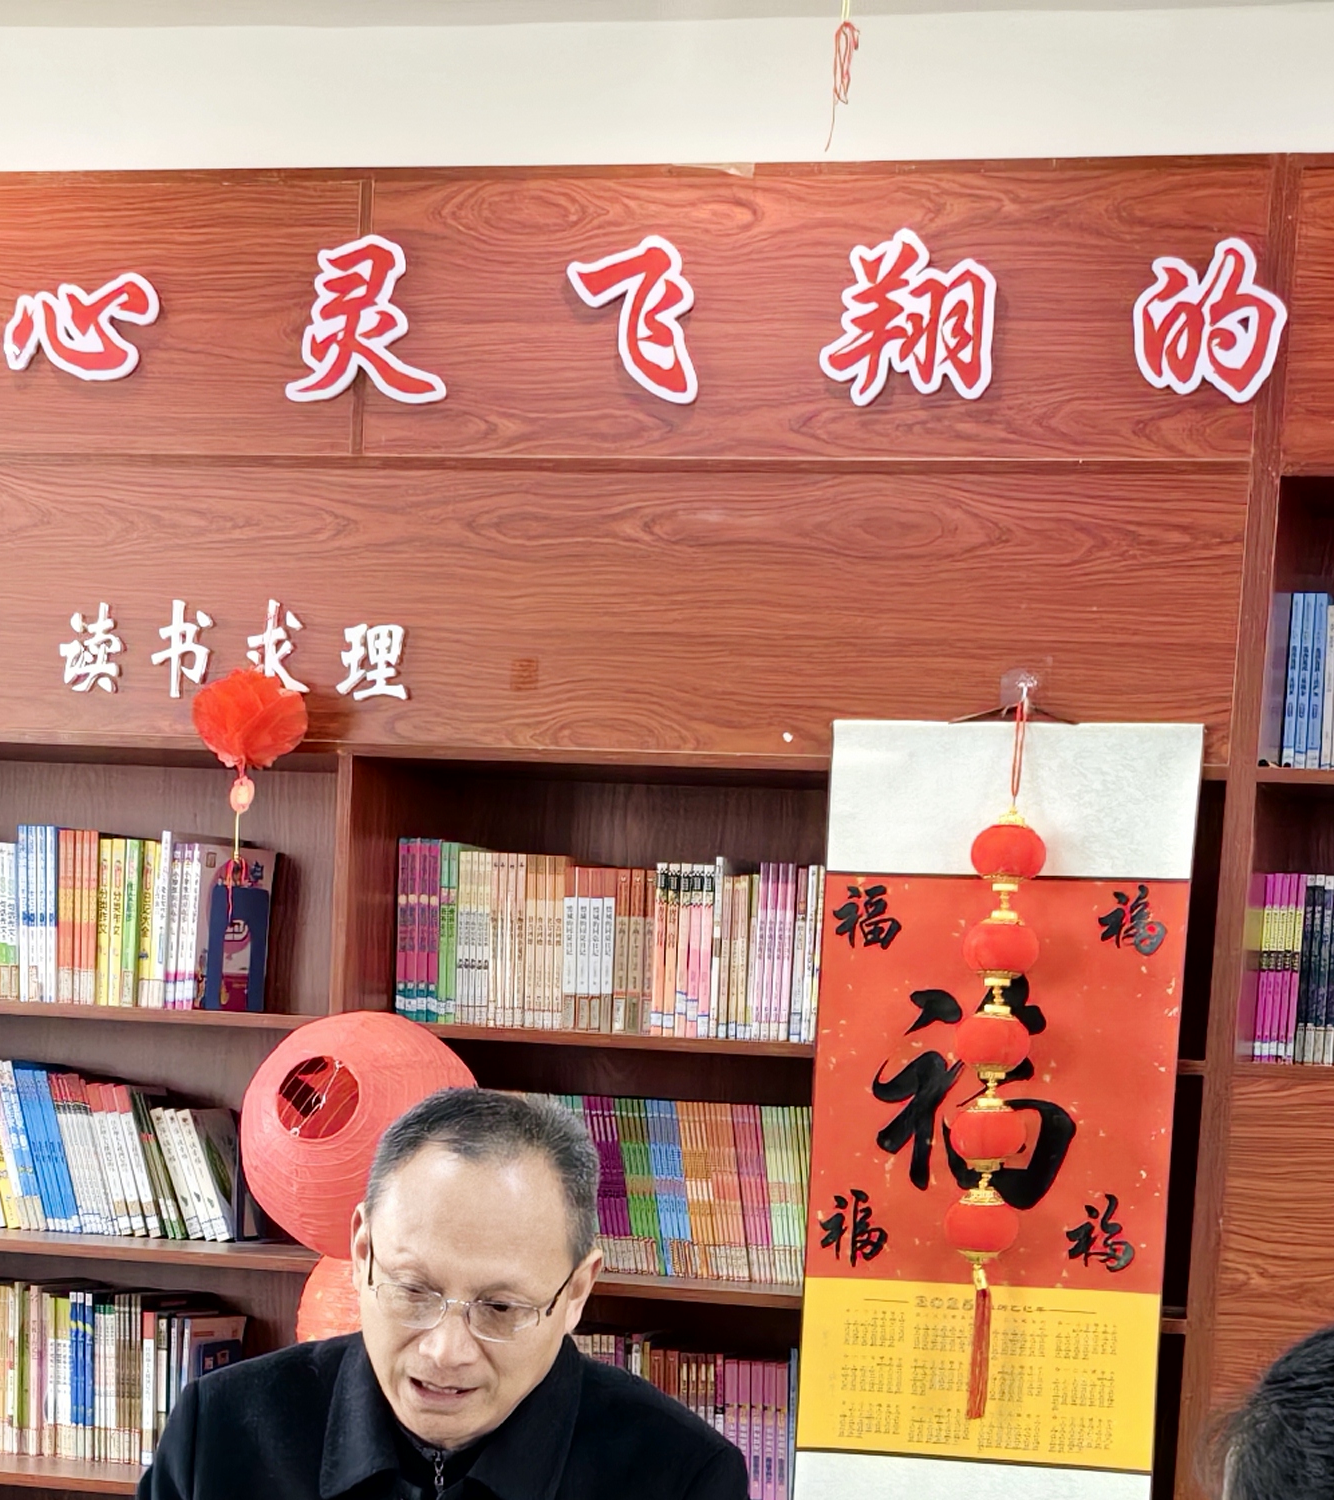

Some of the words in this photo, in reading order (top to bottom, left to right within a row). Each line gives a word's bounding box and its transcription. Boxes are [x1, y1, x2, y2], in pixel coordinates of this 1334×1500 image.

[60, 599, 410, 701] 读书求理
[833, 886, 902, 950] 福
